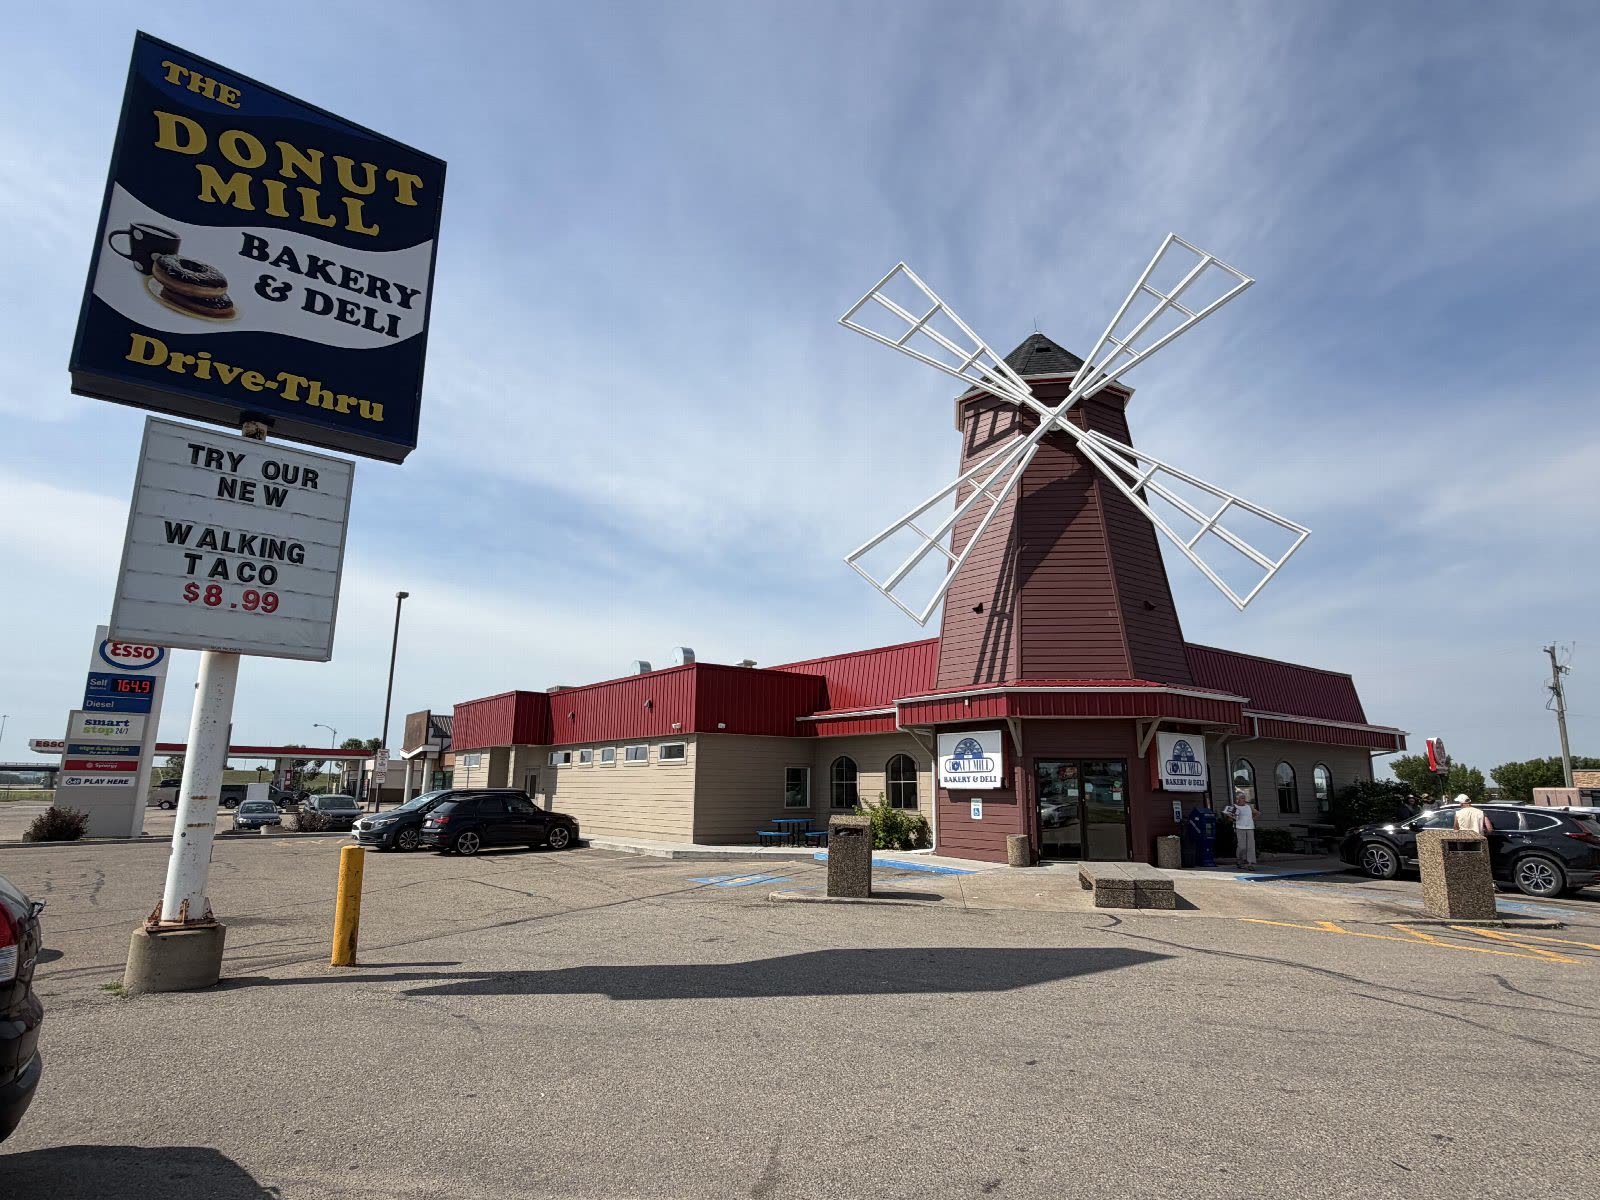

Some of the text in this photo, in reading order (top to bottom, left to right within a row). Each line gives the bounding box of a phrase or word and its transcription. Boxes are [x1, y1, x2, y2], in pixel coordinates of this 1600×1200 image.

[161, 60, 241, 109] THE
[153, 110, 423, 206] DONUT
[195, 163, 380, 237] MILL
[238, 231, 421, 310] BAKERY
[254, 273, 401, 339] & DELI
[125, 332, 385, 422] Drive-Thru
[187, 443, 319, 490] TRY OUR
[217, 476, 289, 508] NEW
[164, 520, 306, 565] WALKING
[183, 553, 278, 586] TACO
[182, 581, 279, 614] $8.99
[84, 719, 130, 727] smart
[86, 700, 115, 708] Diesel
[82, 727, 115, 736] stop
[979, 775, 997, 783] DELI
